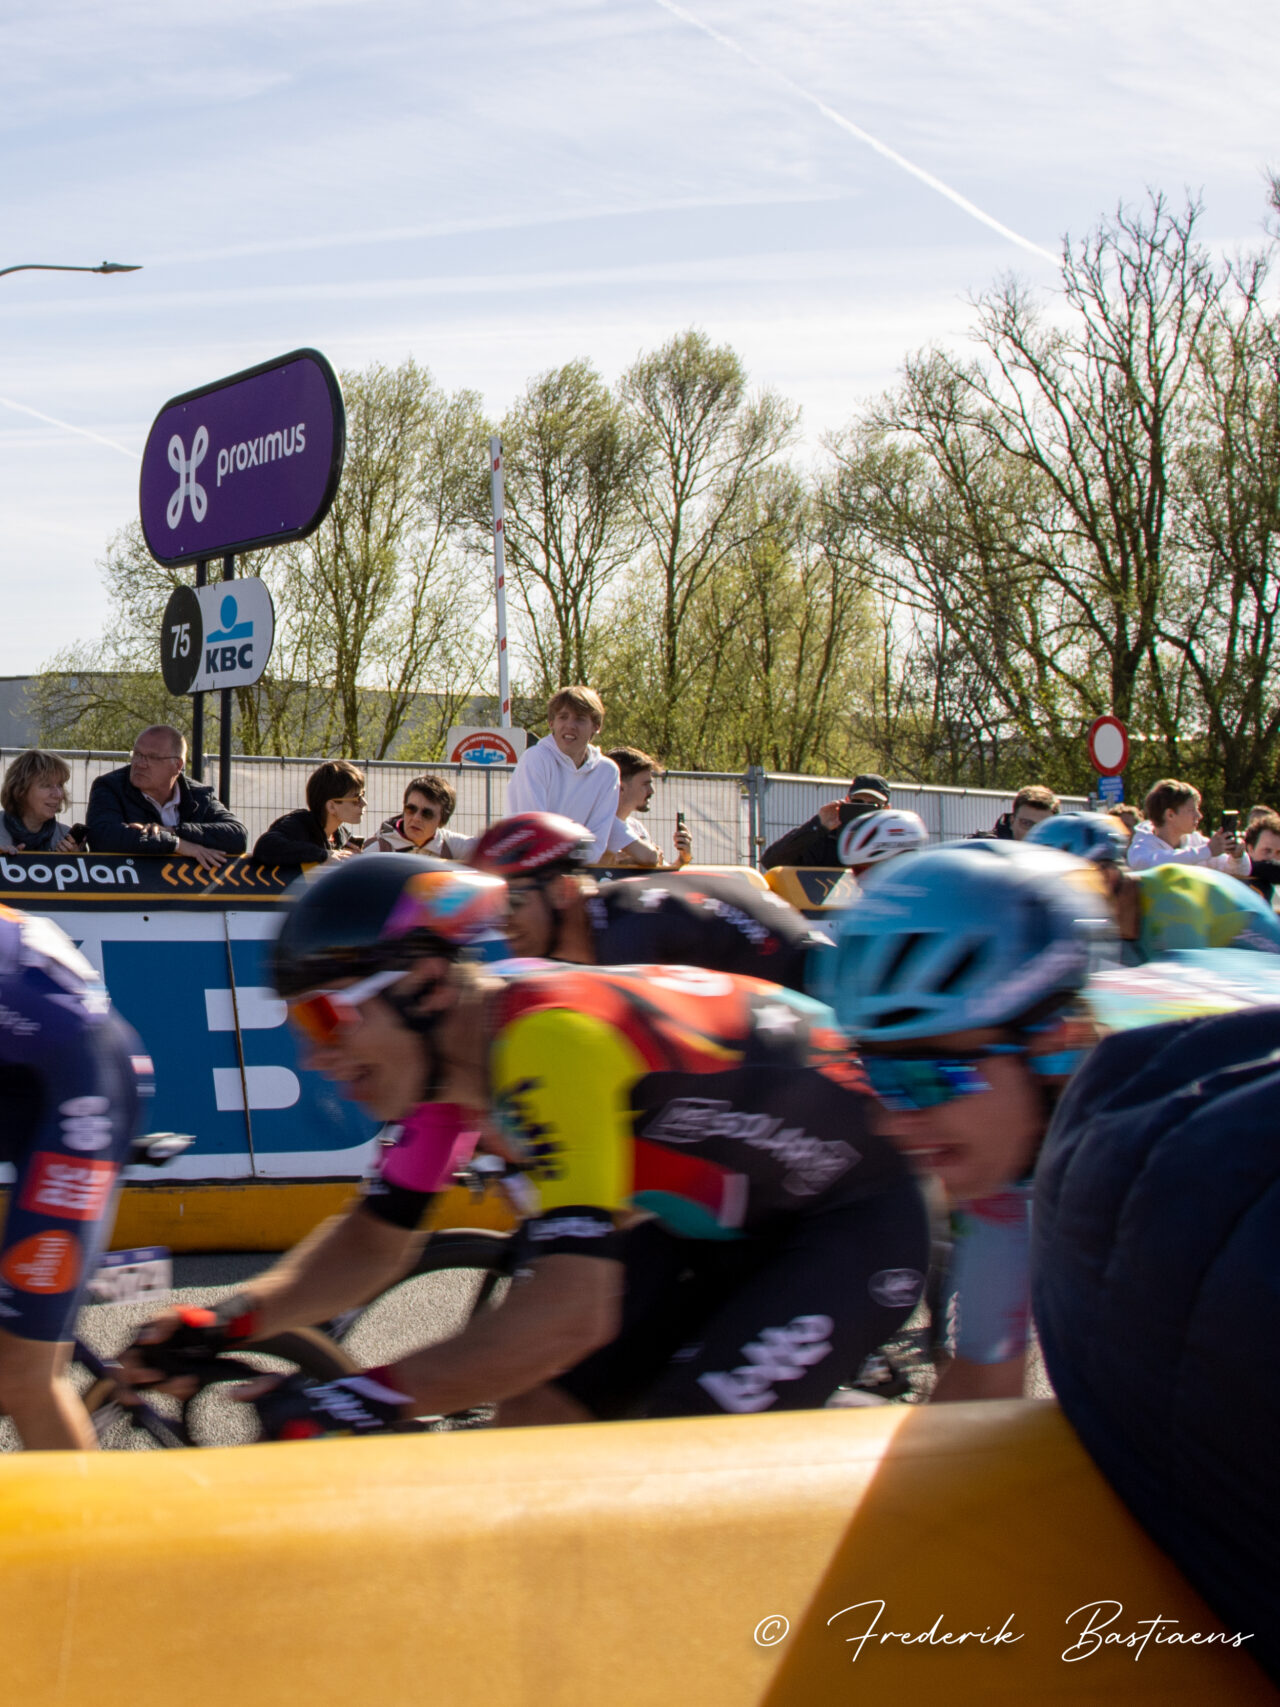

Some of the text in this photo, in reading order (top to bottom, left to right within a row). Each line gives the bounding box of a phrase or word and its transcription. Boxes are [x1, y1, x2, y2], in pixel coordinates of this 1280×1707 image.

[217, 423, 306, 487] proximus
[171, 623, 191, 659] 75
[206, 643, 254, 675] KBC
